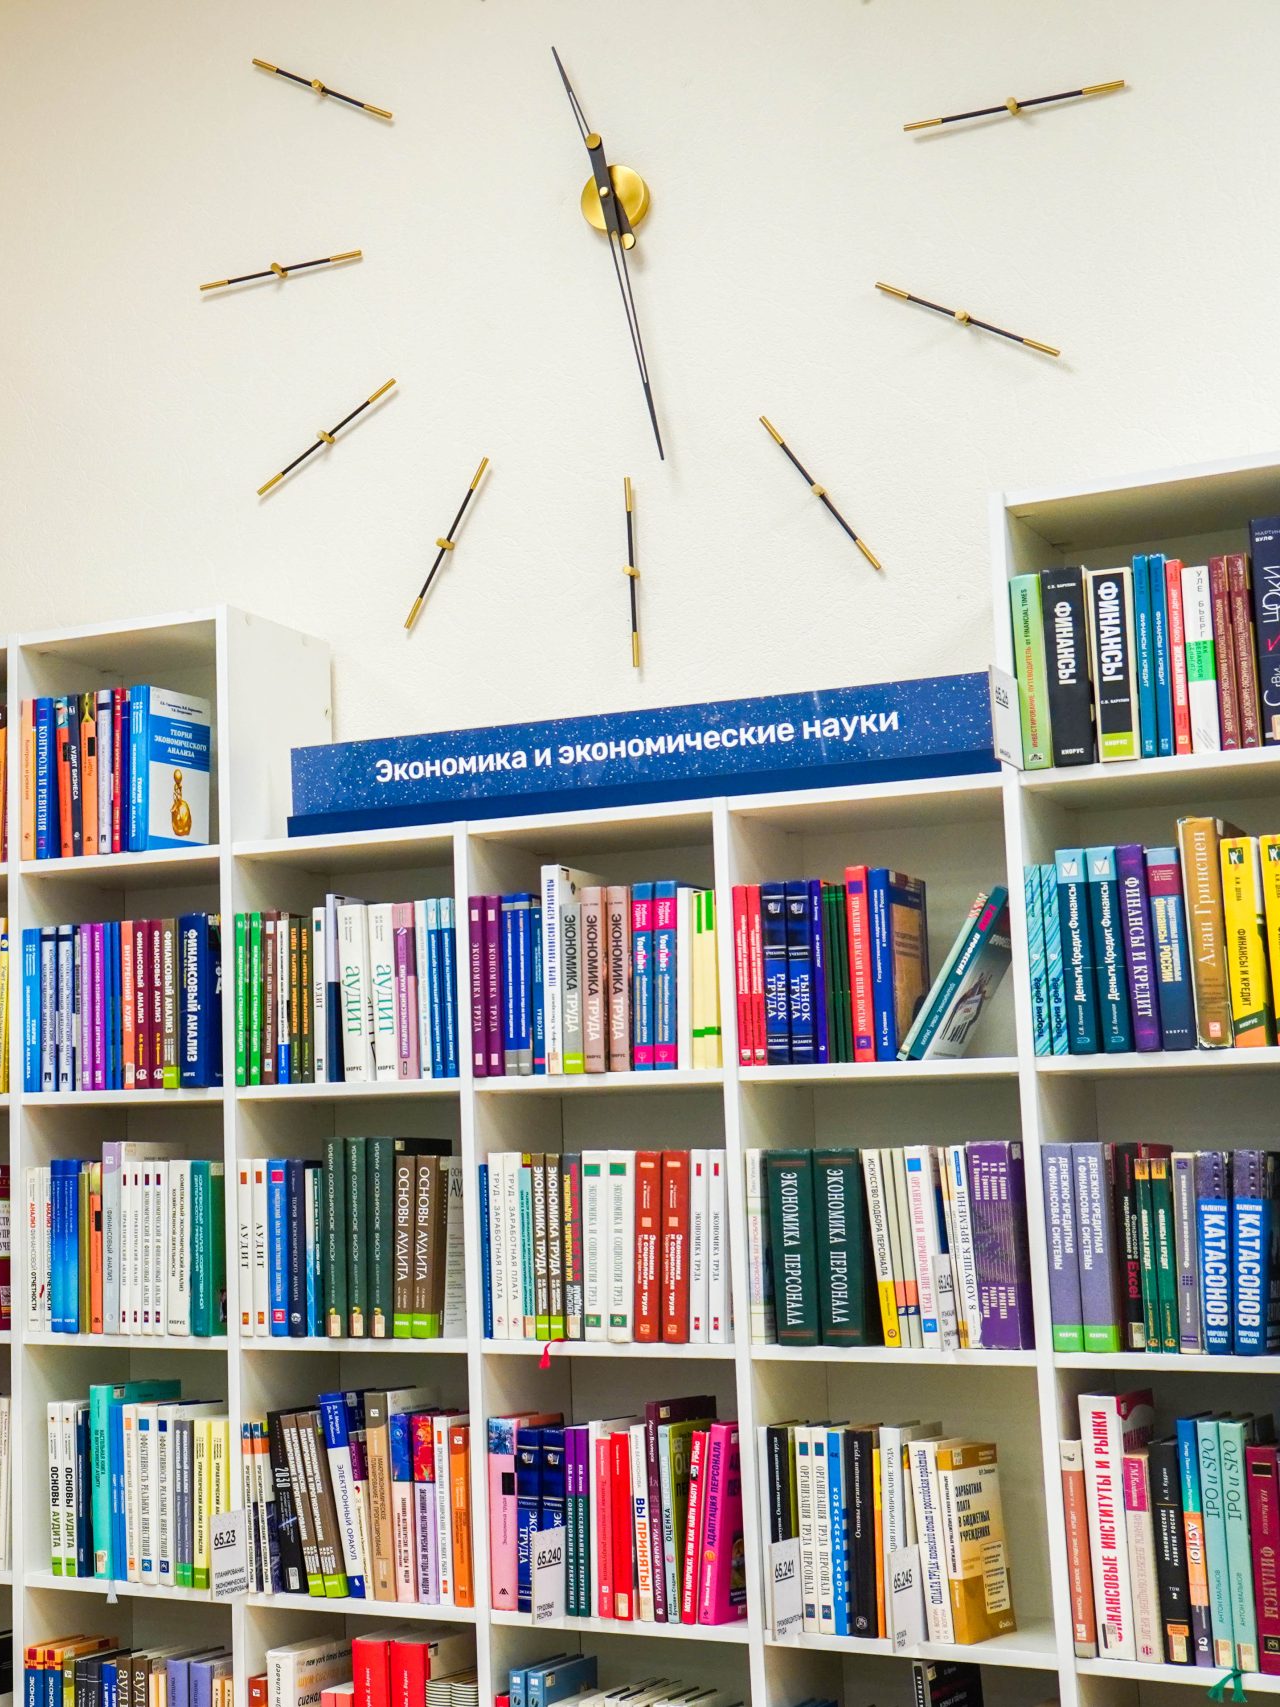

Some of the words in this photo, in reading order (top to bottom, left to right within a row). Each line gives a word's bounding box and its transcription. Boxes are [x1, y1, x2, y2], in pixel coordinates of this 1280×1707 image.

[1054, 601, 1077, 686] ФИНАНСЫ
[1098, 581, 1124, 682] ФИНАНСЫ
[154, 735, 207, 751] ЭКОНОМИЧЕСКОГО
[167, 748, 195, 758] АНАЛИЗА
[170, 729, 193, 740] ТЕОРИЯ
[375, 750, 527, 784] Экономика
[535, 751, 552, 768] и
[558, 722, 794, 768] экономические
[803, 711, 900, 747] науки
[1195, 831, 1215, 917] Гринспен
[1125, 876, 1145, 948] ФИНАНСЫ
[163, 930, 173, 996] ФИНАНСОВЫЙ
[186, 929, 201, 1010] ФИНАНСОВЫЙ
[564, 914, 578, 991] ЭКОНОМИКА
[586, 915, 599, 996] ЭКОНОМИКА
[611, 913, 623, 995] ЭКОНОМИКА
[1198, 924, 1216, 967] Алан
[1237, 928, 1248, 968] ФИНАНСЫ
[342, 966, 362, 1036] аудит
[373, 964, 394, 1035] аудит
[567, 992, 579, 1033] ТРУДА
[766, 975, 777, 1018] ТРУДА
[777, 974, 787, 1020] РЫНОК
[791, 977, 800, 1020] ТРУДА
[800, 974, 810, 1021] РЫНОК
[1134, 964, 1152, 1017] КРЕДИТ
[1240, 976, 1251, 1006] КРЕДИТ
[165, 998, 173, 1033] АНАЛИЗ
[187, 1012, 198, 1062] АНАЛИЗ
[589, 998, 600, 1041] ТРУДА
[613, 997, 624, 1041] ТРУДА
[397, 1168, 410, 1227] ОСНОВЫ
[417, 1167, 431, 1227] ОСНОВЫ
[534, 1166, 545, 1238] ЭКОНОМИКА
[548, 1166, 558, 1238] ЭКОНОМИКА
[780, 1171, 800, 1247] ЭКОНОМИКА
[826, 1168, 843, 1244] ЭКОНОМИКА
[956, 1191, 972, 1241] ВРЕМЕНИ
[1048, 1166, 1060, 1225] ФИНАНСОВАЯ
[1058, 1156, 1074, 1254] ДЕНЕЖНО-КРЕДИТНАЯ
[396, 1230, 409, 1281] АУДИТА
[416, 1230, 429, 1281] АУДИТА
[535, 1239, 546, 1276] ТРУДА
[549, 1239, 560, 1276] ТРУДА
[961, 1244, 976, 1301] ЛОВУШЕК
[1051, 1227, 1062, 1270] СИСТЕМЫ
[1203, 1214, 1229, 1327] КАТАСОНОВ
[1238, 1213, 1261, 1327] КАТАСОНОВ
[784, 1253, 805, 1326] ПЕРСОНАЛА
[829, 1251, 850, 1323] ПЕРСОНАЛА
[1127, 1261, 1139, 1298] Excel
[1092, 1411, 1109, 1455] РЫНКИ
[1202, 1438, 1216, 1475] SPO
[274, 1467, 290, 1488] 2030
[712, 1441, 721, 1492] ПЕРСОНАЛА
[1223, 1440, 1238, 1476] SPO
[50, 1466, 59, 1507] ОСНОВЫ
[65, 1467, 73, 1508] ОСНОВЫ
[636, 1497, 646, 1519] ВЫ
[955, 1482, 982, 1497] ЗАРАБОТНАЯ
[956, 1501, 971, 1512] ПЛАТА
[1206, 1489, 1220, 1519] IPO
[1228, 1491, 1242, 1521] IPO
[51, 1511, 61, 1548] АУДИТА
[65, 1512, 75, 1548] АУДИТА
[337, 1464, 352, 1523] ЭЛЕКТРОННЫЙ
[347, 1525, 357, 1560] ОРАКУЛ
[709, 1493, 720, 1547] АДАПТАЦИЯ
[833, 1488, 841, 1550] КОМАНДНАЯ
[1097, 1474, 1116, 1549] ИНСТИТУТЫ
[214, 1530, 236, 1546] 65.23
[537, 1547, 562, 1564] 65.240
[637, 1521, 650, 1591] ПРИНЯТЫ!
[214, 1567, 245, 1579] ПЛАНИРОВАНИЕ
[774, 1560, 794, 1579] 65.241
[894, 1568, 912, 1589] 65.245
[1260, 1547, 1278, 1619] ФИНАНСЫ
[537, 1602, 554, 1612] ТРУДОВЫЕ
